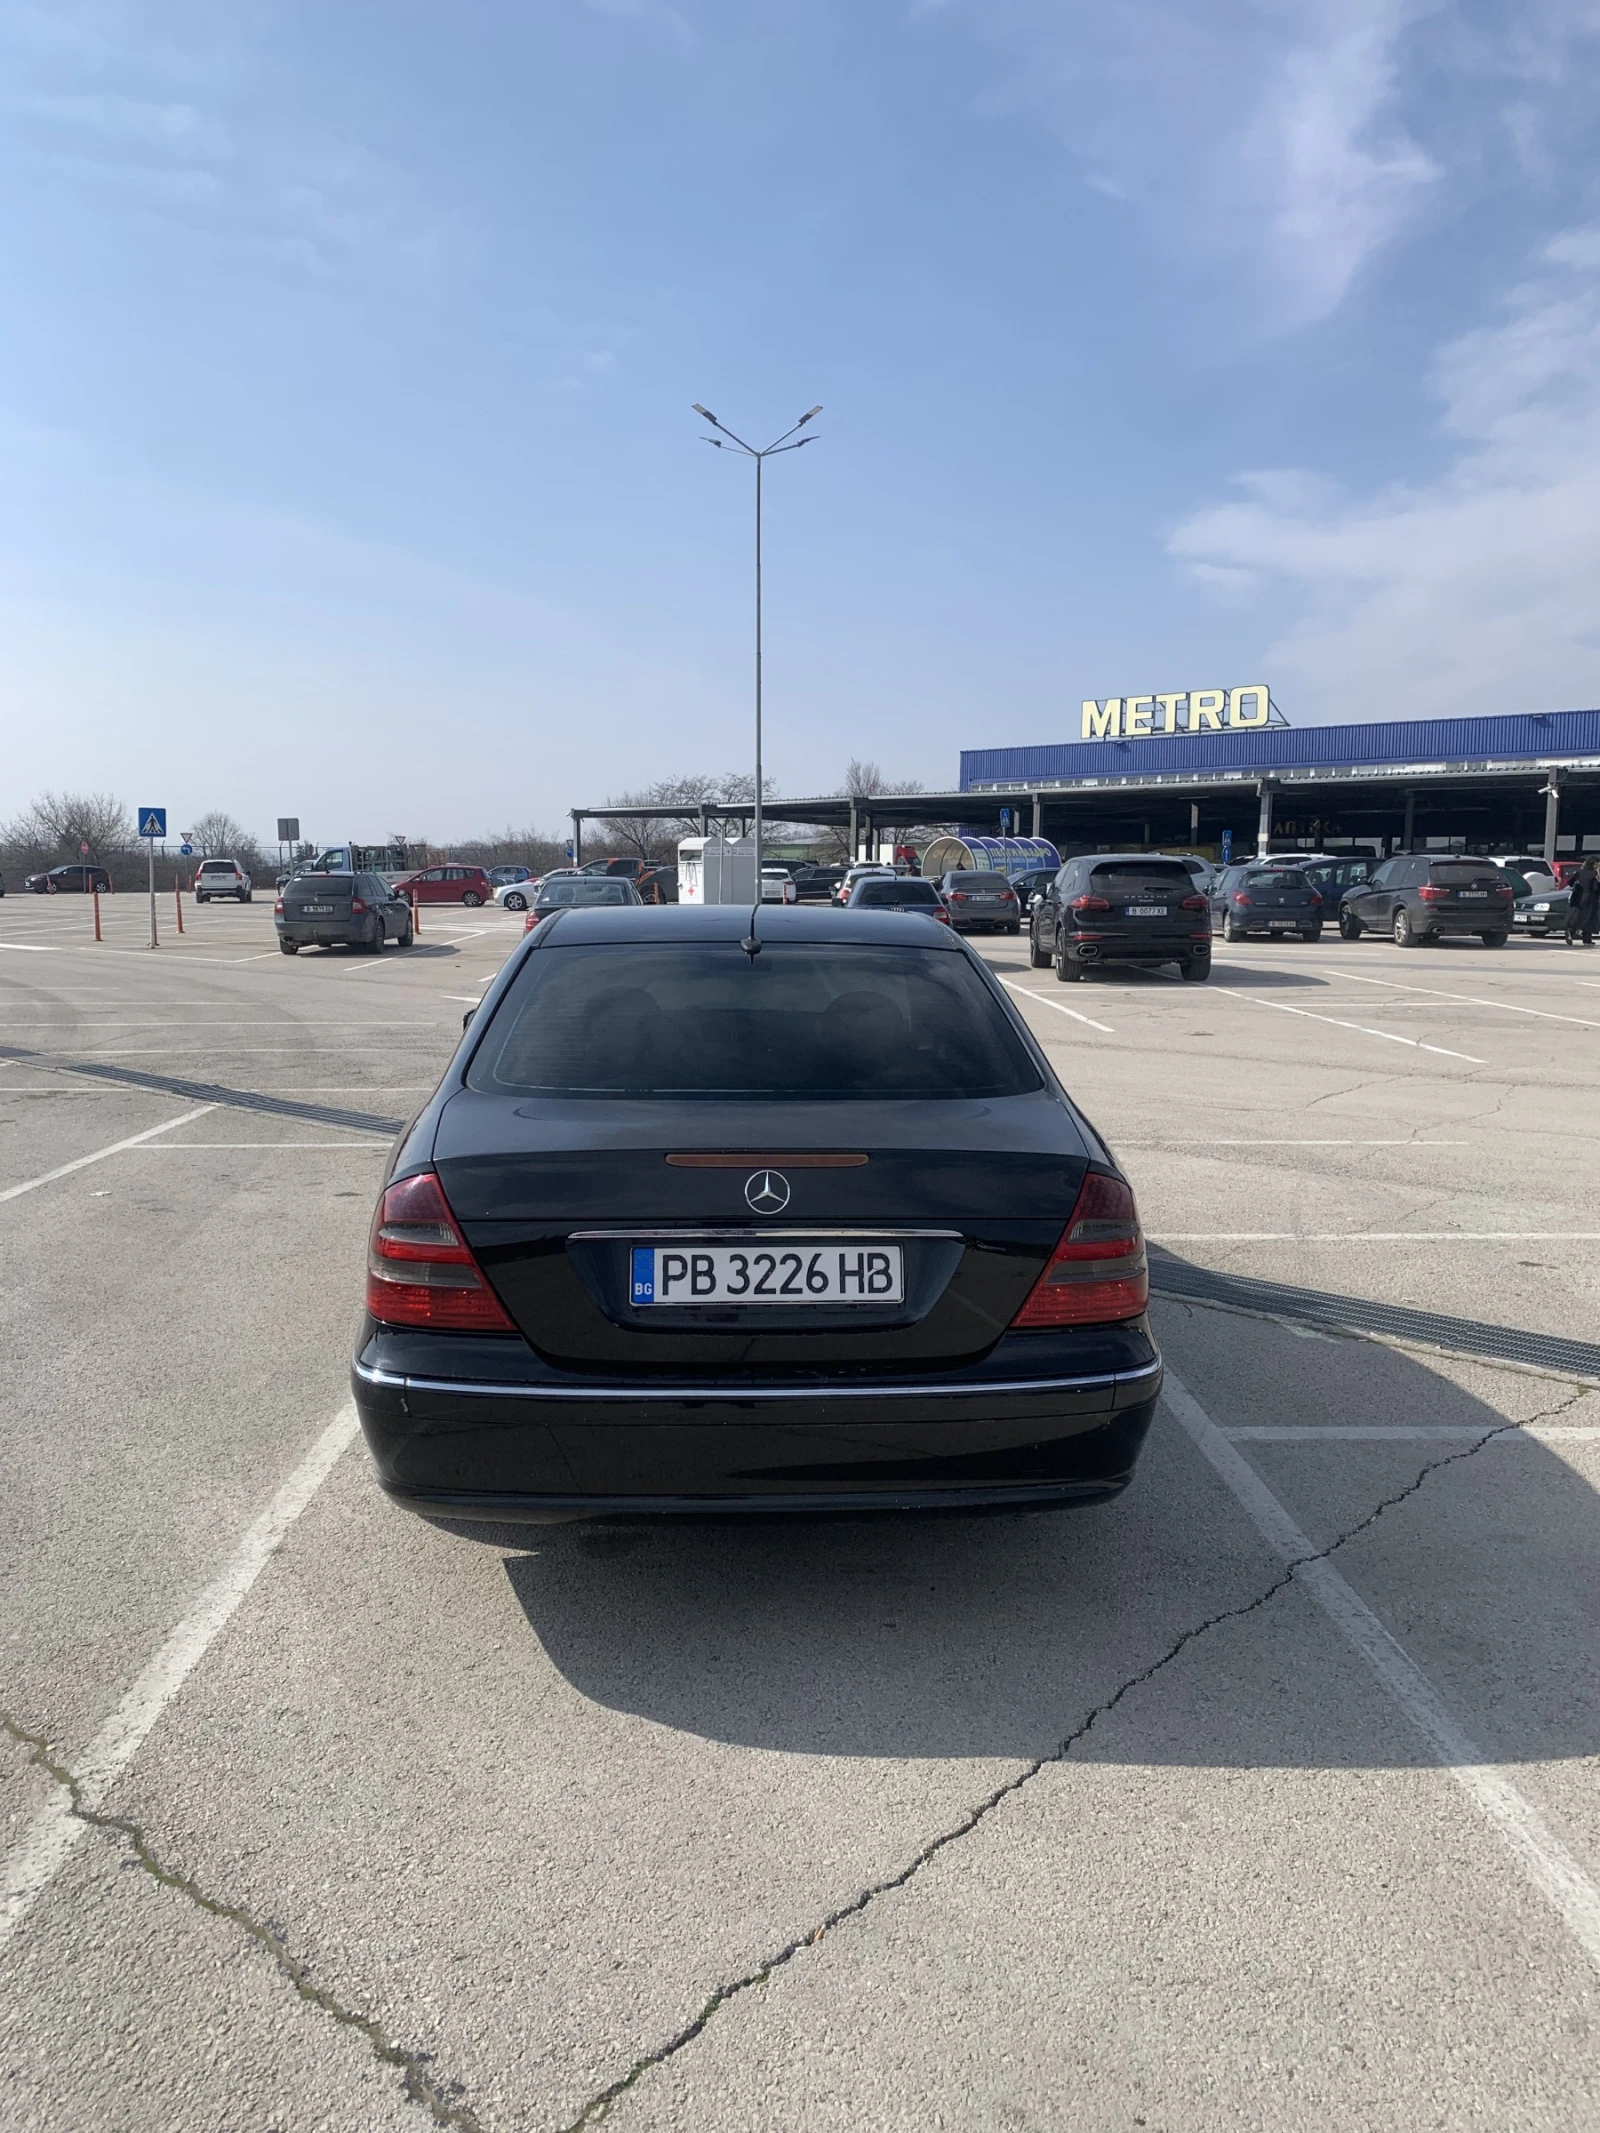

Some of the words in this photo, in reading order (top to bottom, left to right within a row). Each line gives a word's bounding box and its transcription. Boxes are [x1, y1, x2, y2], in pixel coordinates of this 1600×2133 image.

[1081, 684, 1269, 739] METRO
[635, 1282, 653, 1296] BG
[662, 1254, 717, 1296] PB
[726, 1253, 829, 1295] 3226
[838, 1252, 893, 1294] HB
